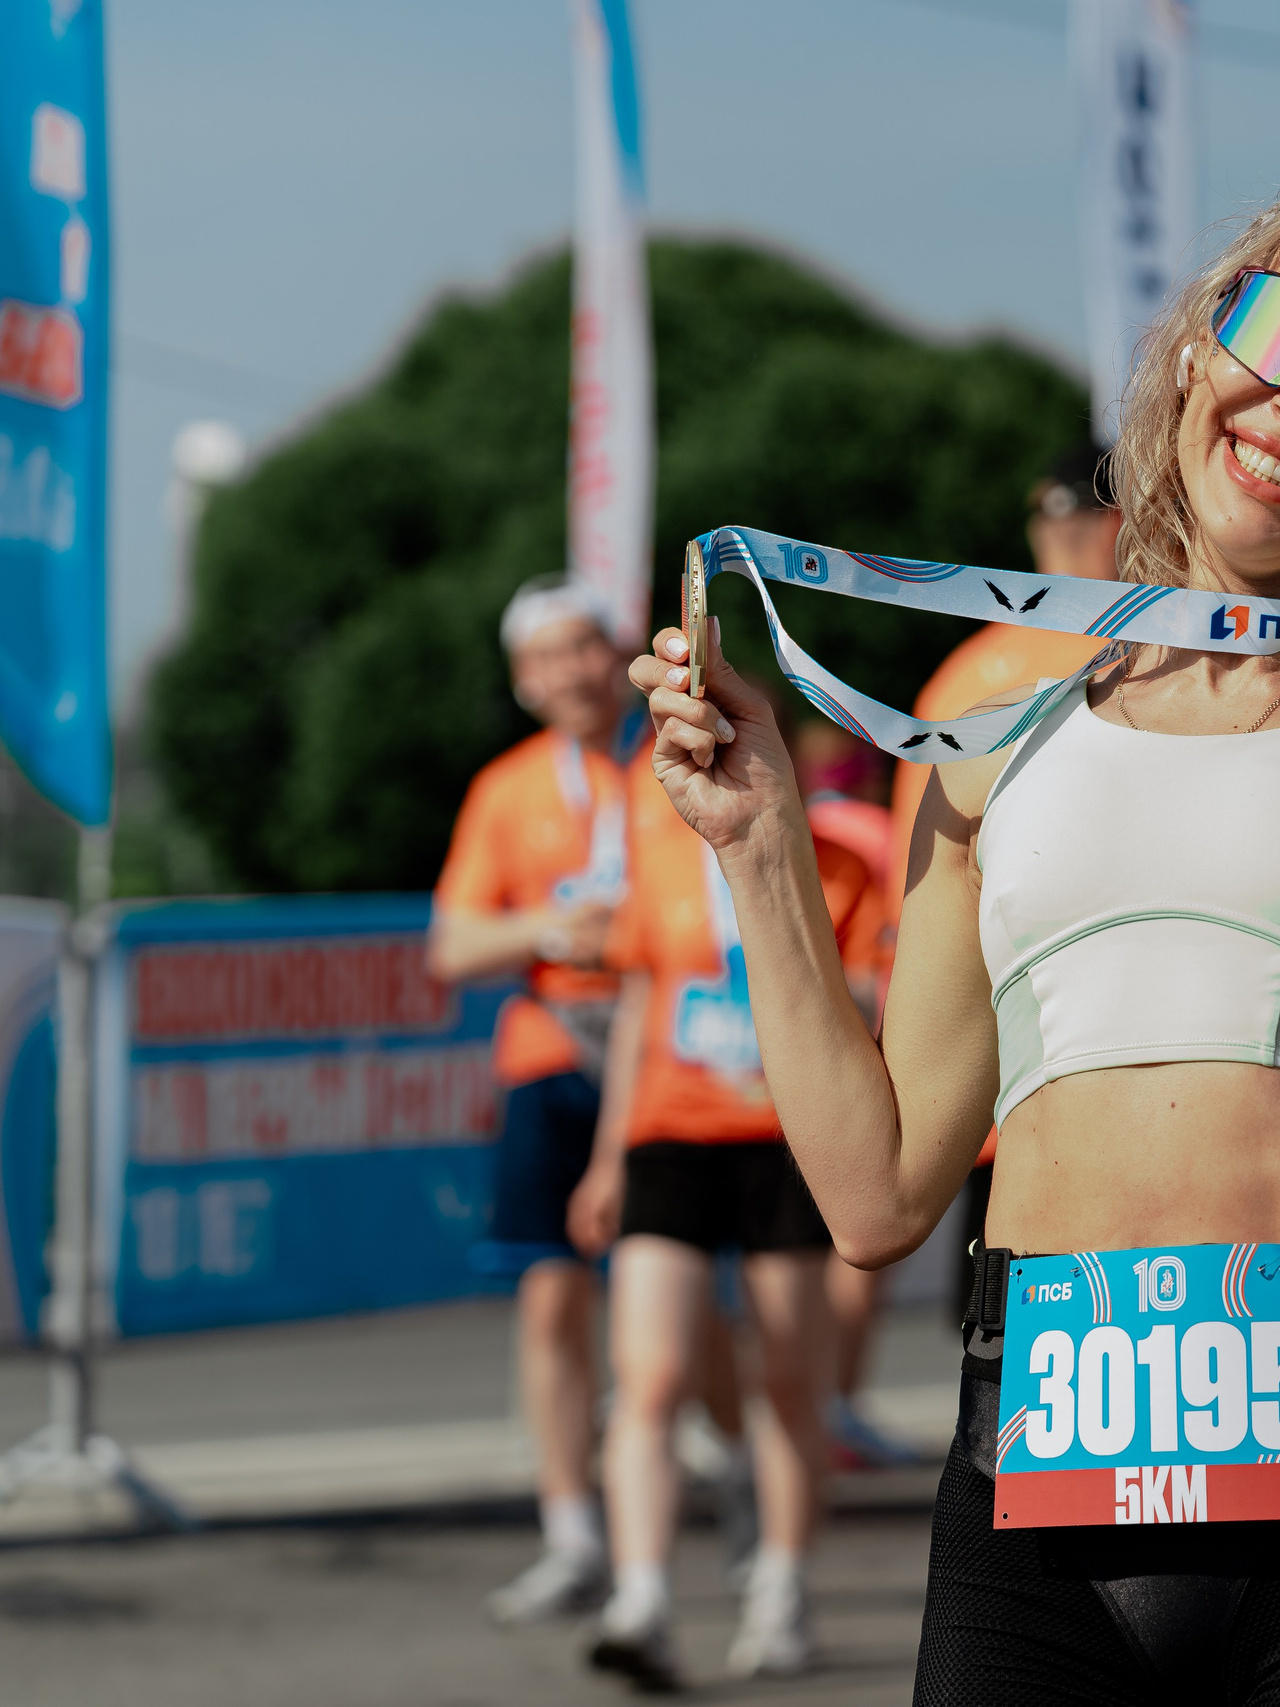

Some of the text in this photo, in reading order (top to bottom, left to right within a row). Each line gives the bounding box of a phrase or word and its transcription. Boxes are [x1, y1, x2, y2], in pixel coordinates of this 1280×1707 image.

[777, 543, 828, 584] 10
[1038, 1282, 1073, 1303] ПСБ
[1132, 1255, 1187, 1313] 10
